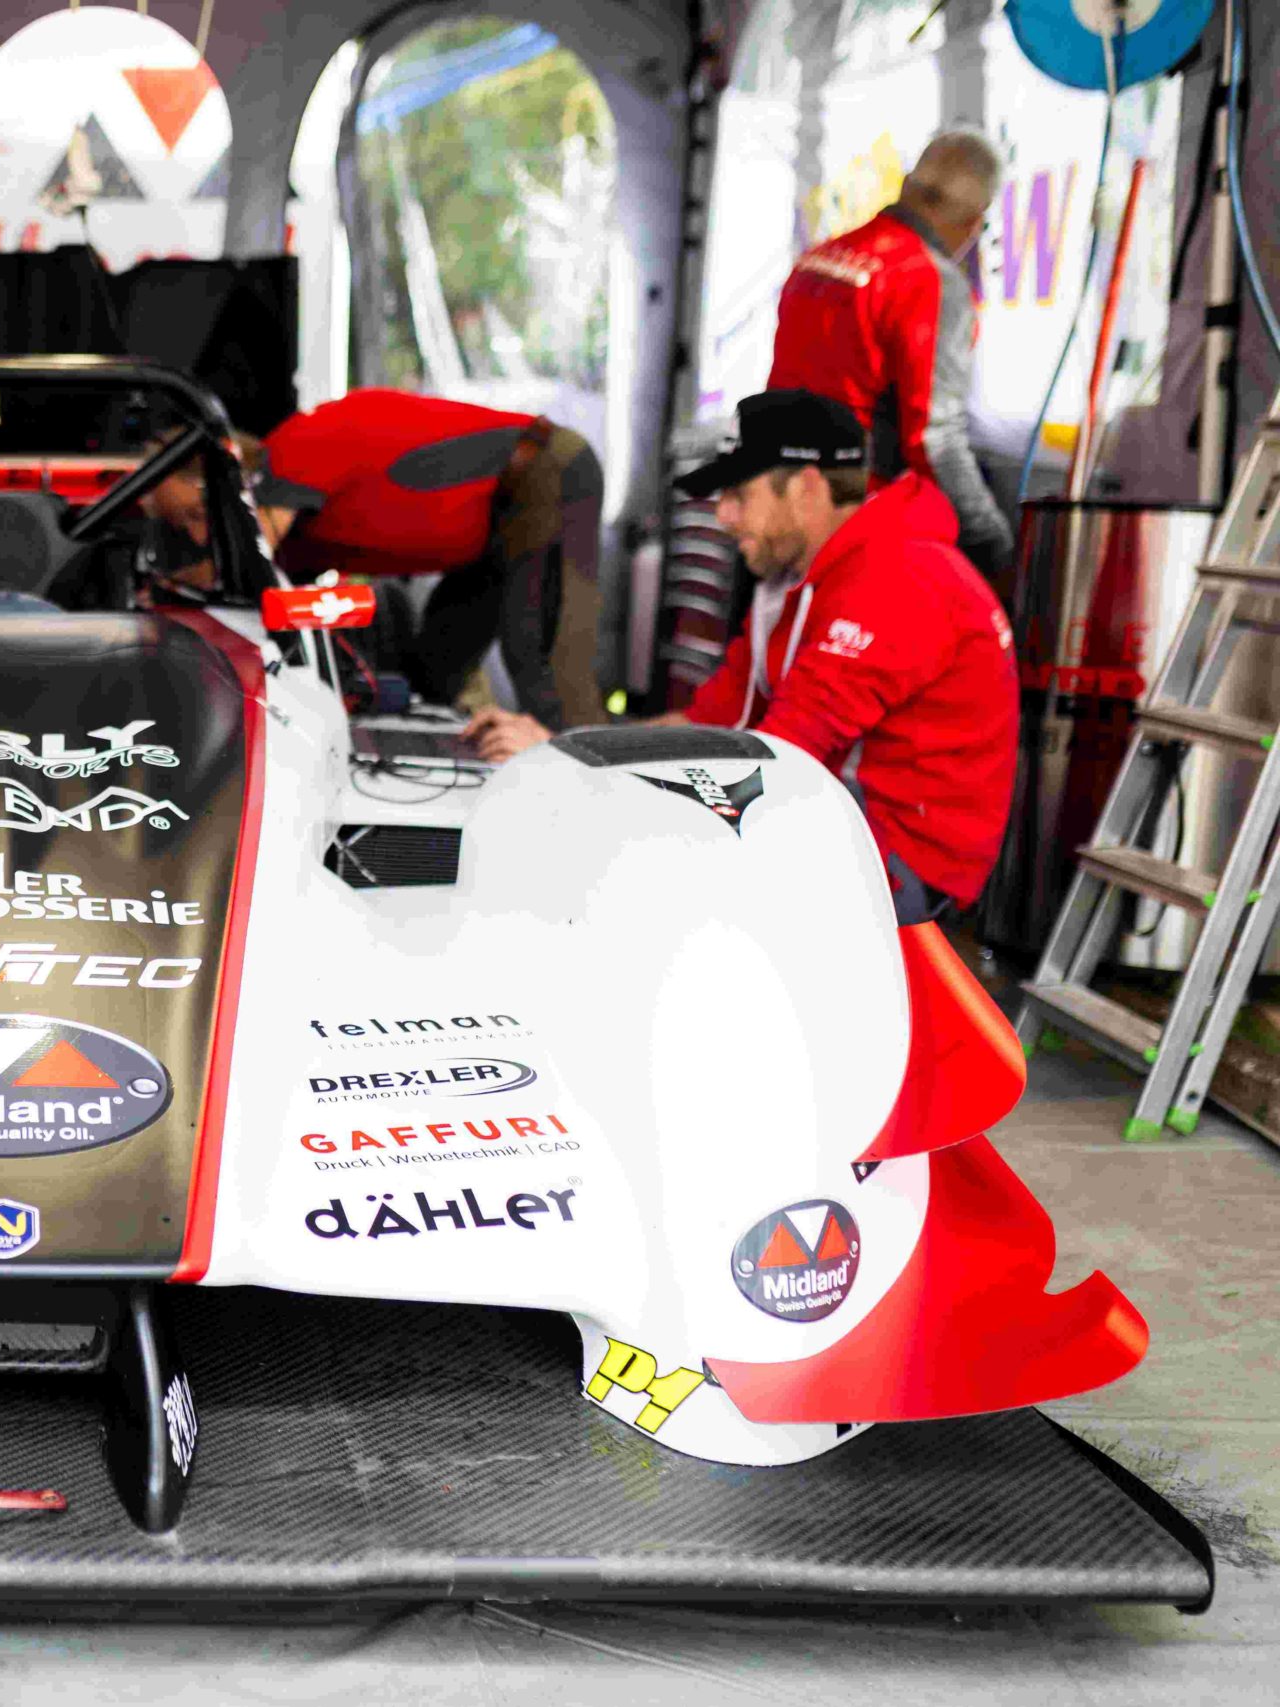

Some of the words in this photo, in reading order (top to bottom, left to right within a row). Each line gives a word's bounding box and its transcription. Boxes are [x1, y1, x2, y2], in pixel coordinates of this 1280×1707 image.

[310, 1014, 521, 1039] felman
[309, 1065, 503, 1093] DREXLER
[317, 1088, 432, 1104] AUTOMOTIVE
[59, 1127, 95, 1141] Oil.
[300, 1114, 569, 1154] GAFFURI
[314, 1158, 373, 1171] Druck
[389, 1145, 521, 1166] Werbetechnik
[539, 1140, 581, 1153] CAD
[763, 1262, 848, 1300] Midland
[776, 1301, 806, 1313] Swiss
[806, 1295, 832, 1309] Quality
[586, 1335, 706, 1434] P1
